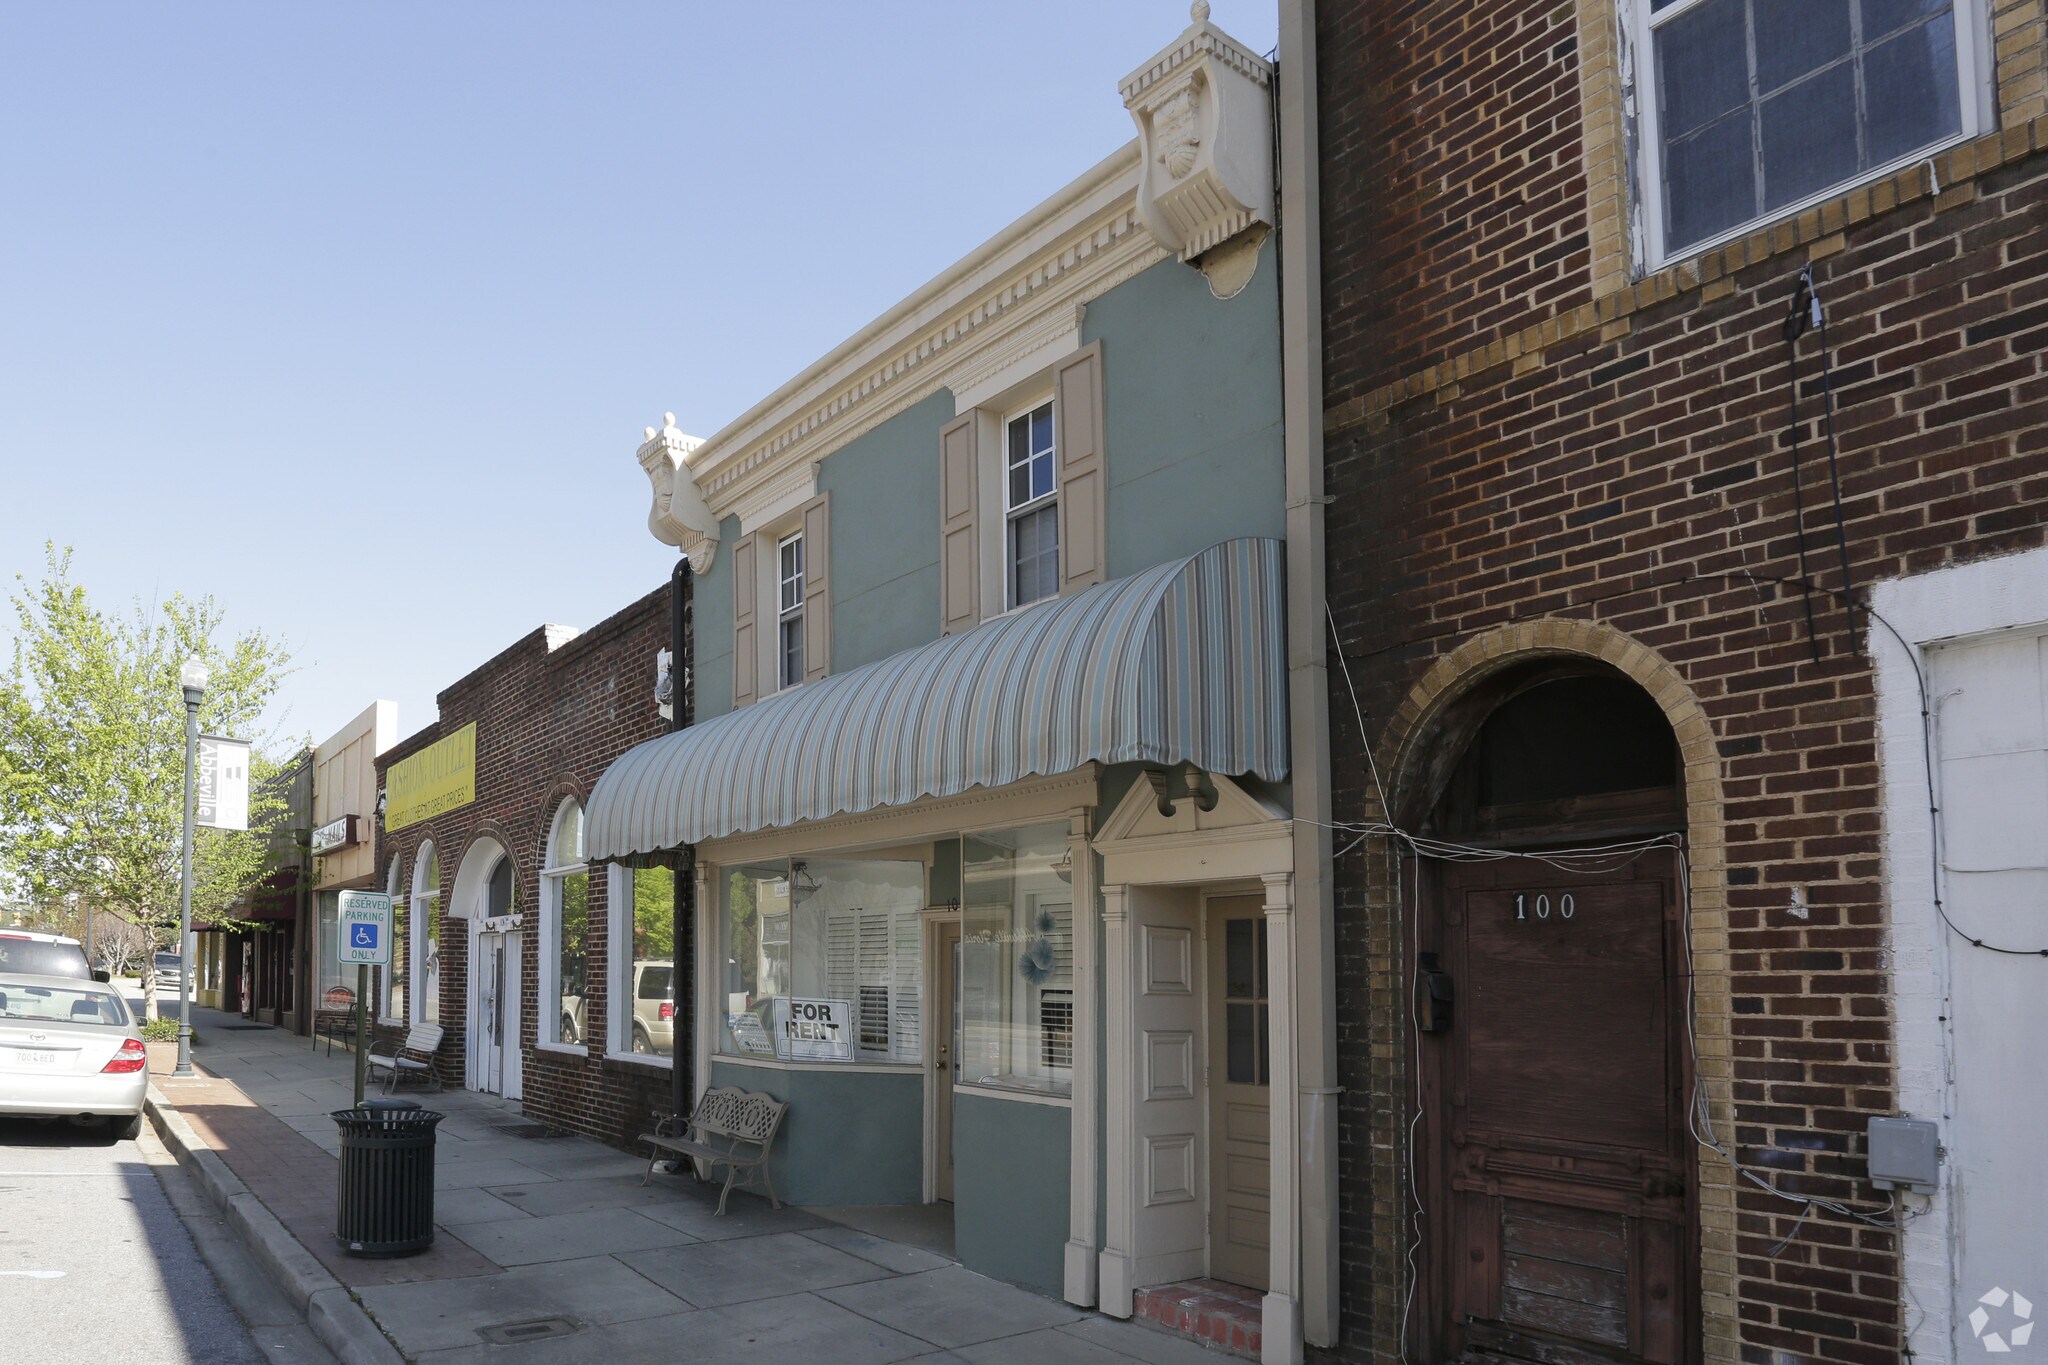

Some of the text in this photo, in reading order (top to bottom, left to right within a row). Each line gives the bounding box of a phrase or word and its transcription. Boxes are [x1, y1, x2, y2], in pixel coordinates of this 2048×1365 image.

[429, 725, 476, 783] OUTLET
[199, 743, 217, 817] Abbeville
[430, 794, 446, 814] GREAT
[344, 898, 388, 910] RESERVED
[1516, 893, 1575, 919] 100
[345, 910, 384, 922] PARKING
[351, 950, 377, 960] ONLY
[791, 1003, 831, 1021] FOR
[785, 1021, 839, 1040] RENT
